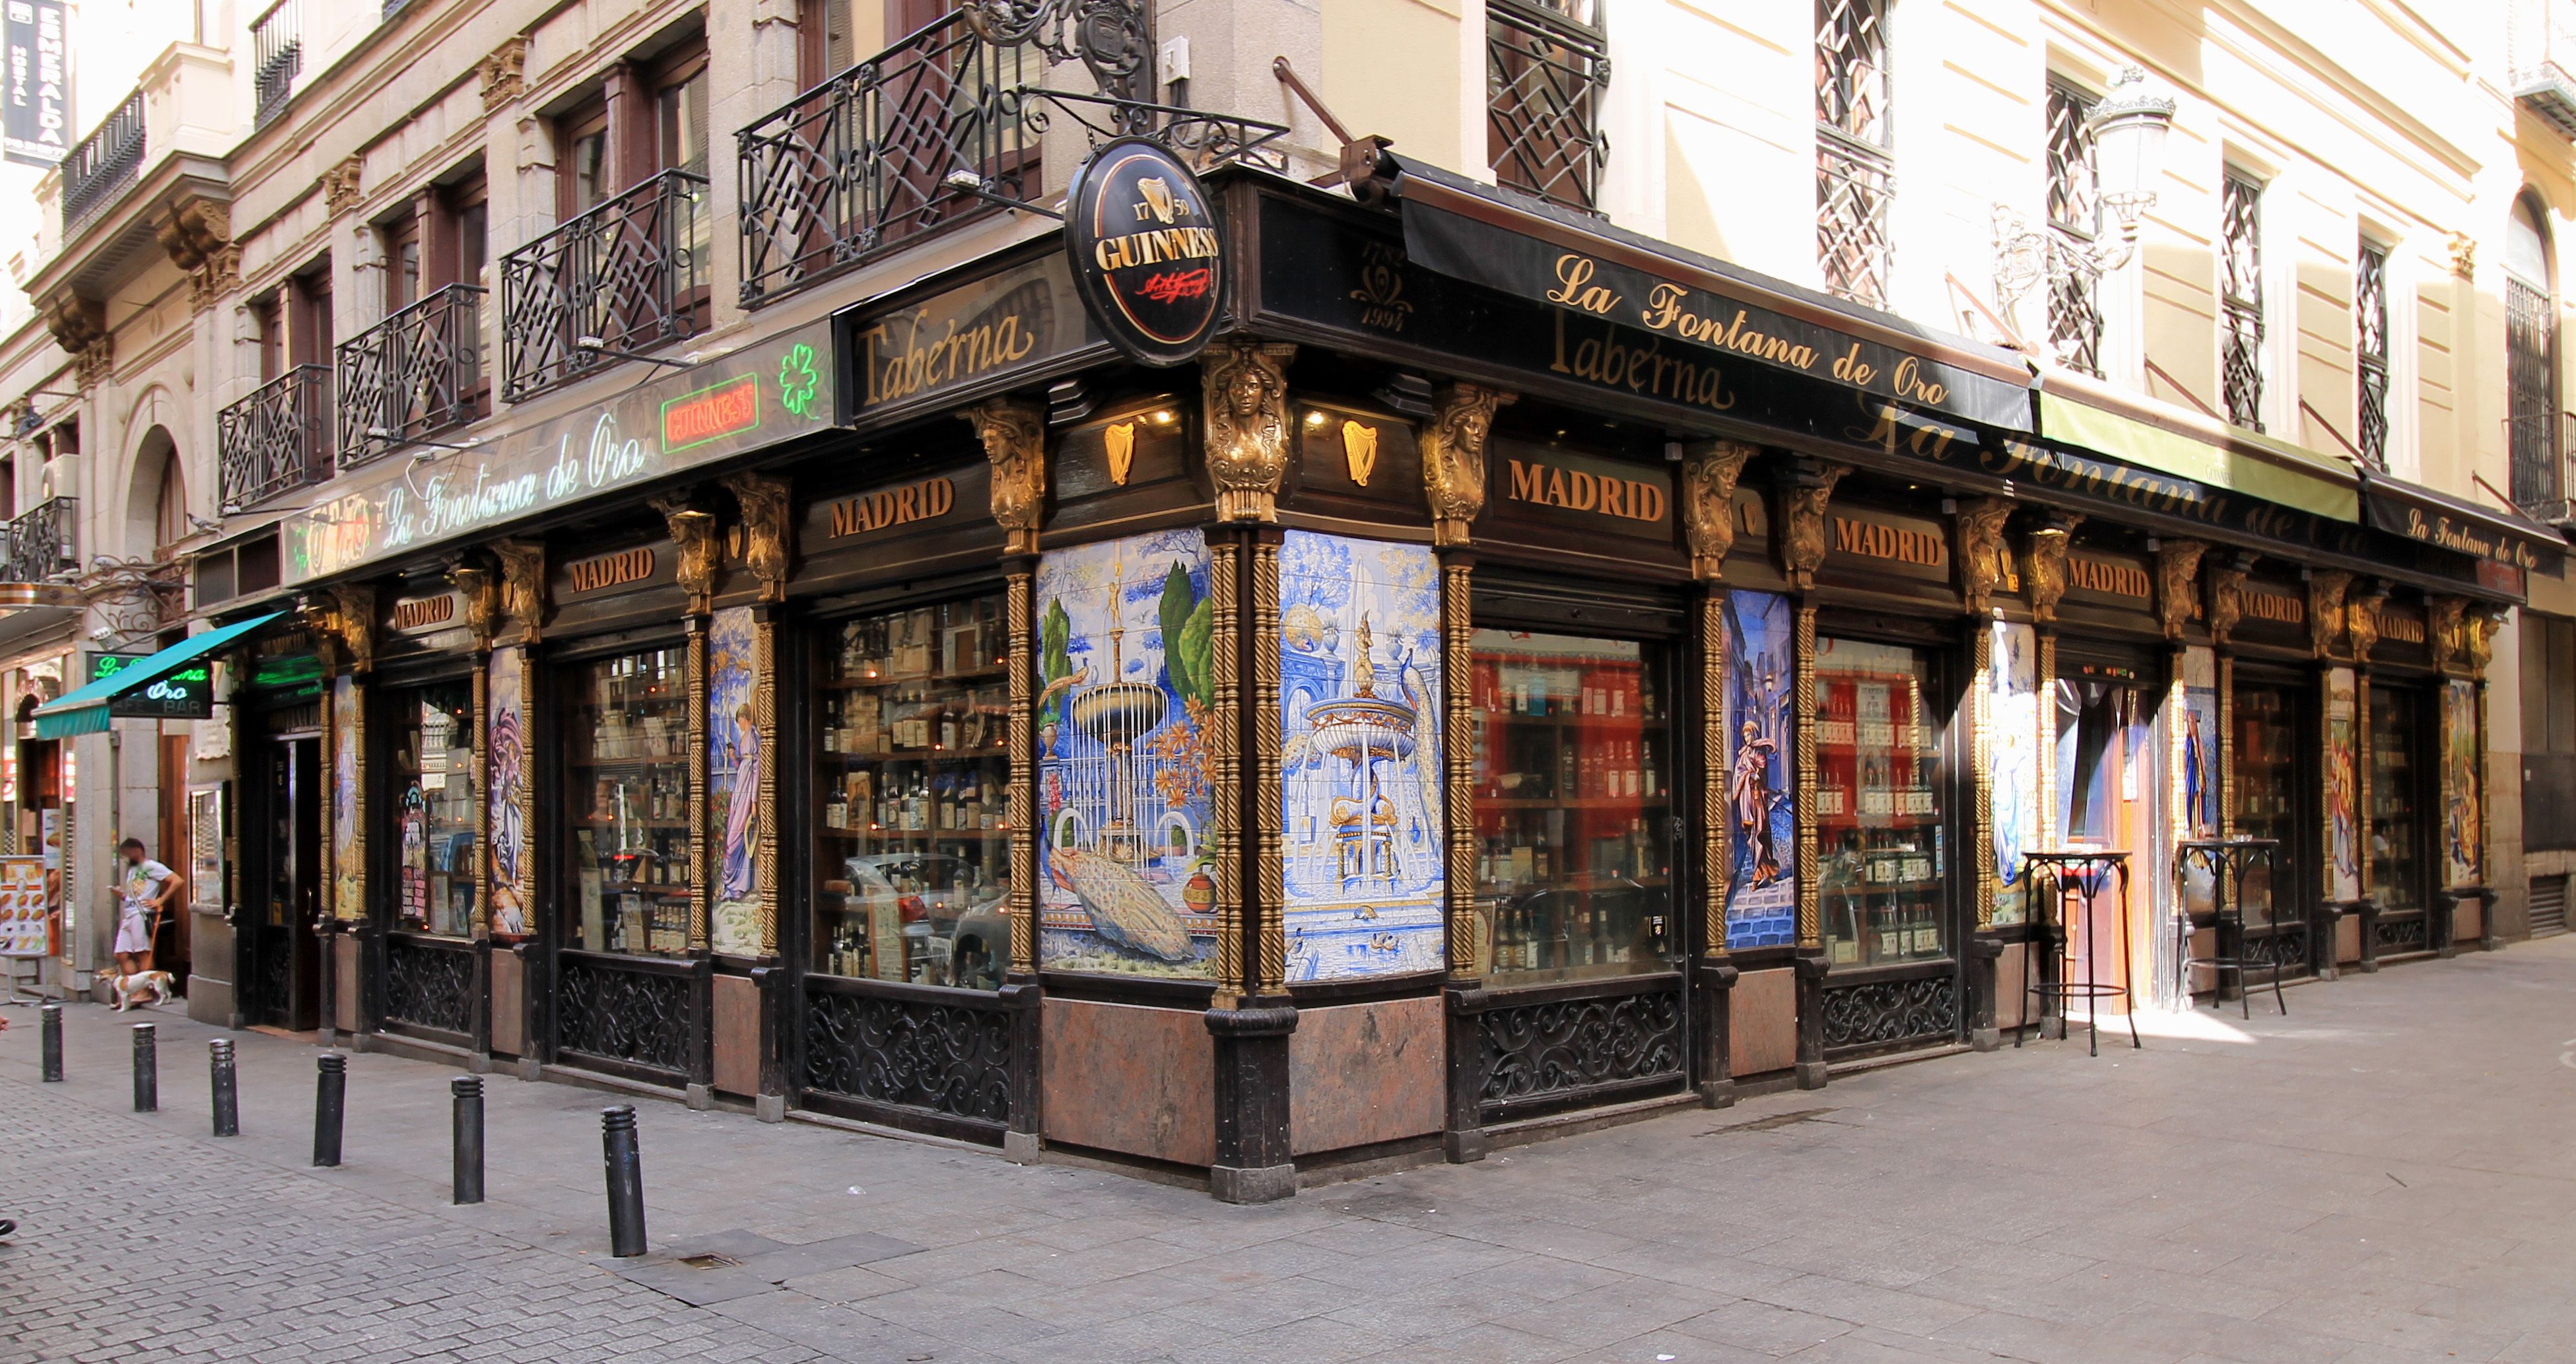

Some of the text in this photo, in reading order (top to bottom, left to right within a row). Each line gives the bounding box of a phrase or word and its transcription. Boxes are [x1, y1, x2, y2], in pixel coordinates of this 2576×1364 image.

[11, 45, 27, 106] HOSTAL
[38, 7, 63, 145] ESMERALDA
[1132, 199, 1190, 221] 17 59
[1095, 226, 1219, 271] GUINNESS
[1547, 254, 1949, 404] La Fontana de Oro
[858, 308, 1034, 406] Taberna
[666, 382, 755, 442] GUINNESS
[384, 487, 415, 549] La
[422, 463, 537, 536] Fontana
[547, 433, 581, 500] de
[588, 413, 646, 488] Oro
[829, 477, 955, 539] MADRID
[1507, 458, 1664, 522] MADRID
[1833, 516, 1944, 567] MADRID
[2407, 508, 2538, 569] La Fontana de Oro
[571, 547, 655, 594] MADRID
[2068, 557, 2150, 598] MADRID
[395, 596, 453, 630] MADRID
[2241, 589, 2302, 623] MADRID
[2375, 611, 2424, 644] MADRID
[147, 680, 187, 699] Oro
